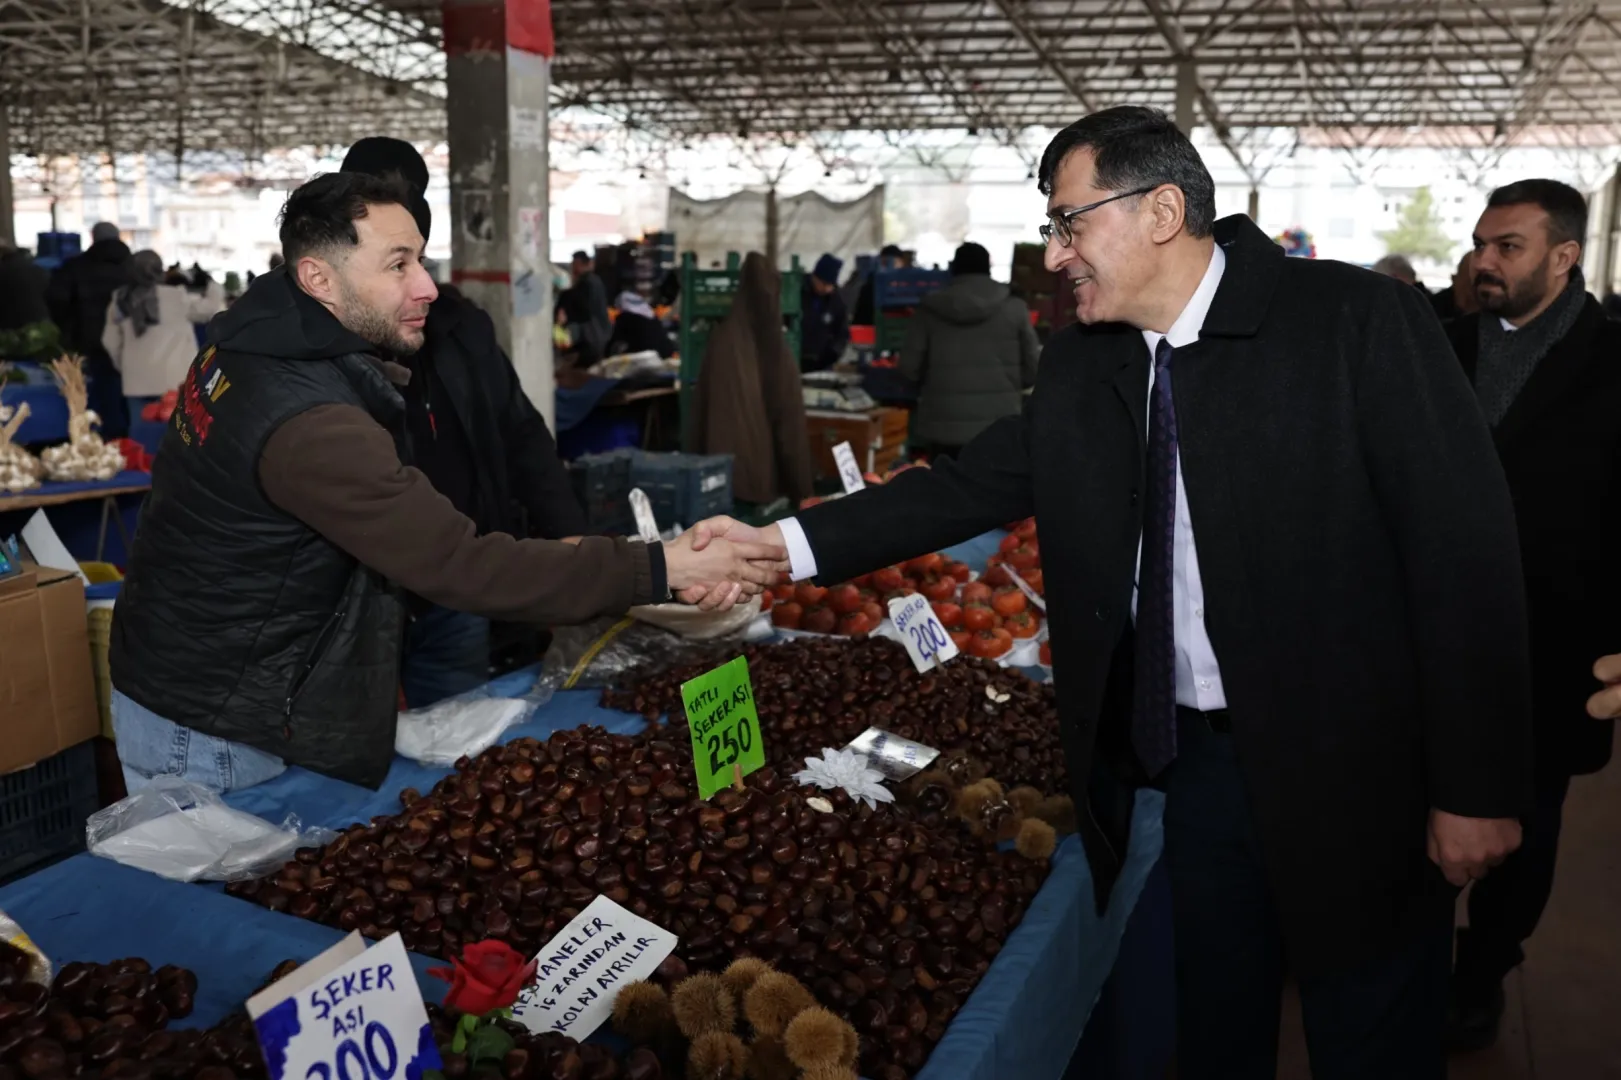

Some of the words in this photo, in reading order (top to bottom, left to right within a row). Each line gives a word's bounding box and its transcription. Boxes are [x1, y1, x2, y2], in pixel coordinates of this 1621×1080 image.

[909, 616, 947, 662] 200
[688, 686, 719, 714] TATLI
[707, 716, 752, 776] 250
[310, 963, 395, 1021] ŞEKER
[550, 986, 599, 1032] KOLAY
[596, 935, 659, 989] AYRILIR
[551, 931, 627, 995] ZARINDAN
[333, 1004, 365, 1039] AŞI
